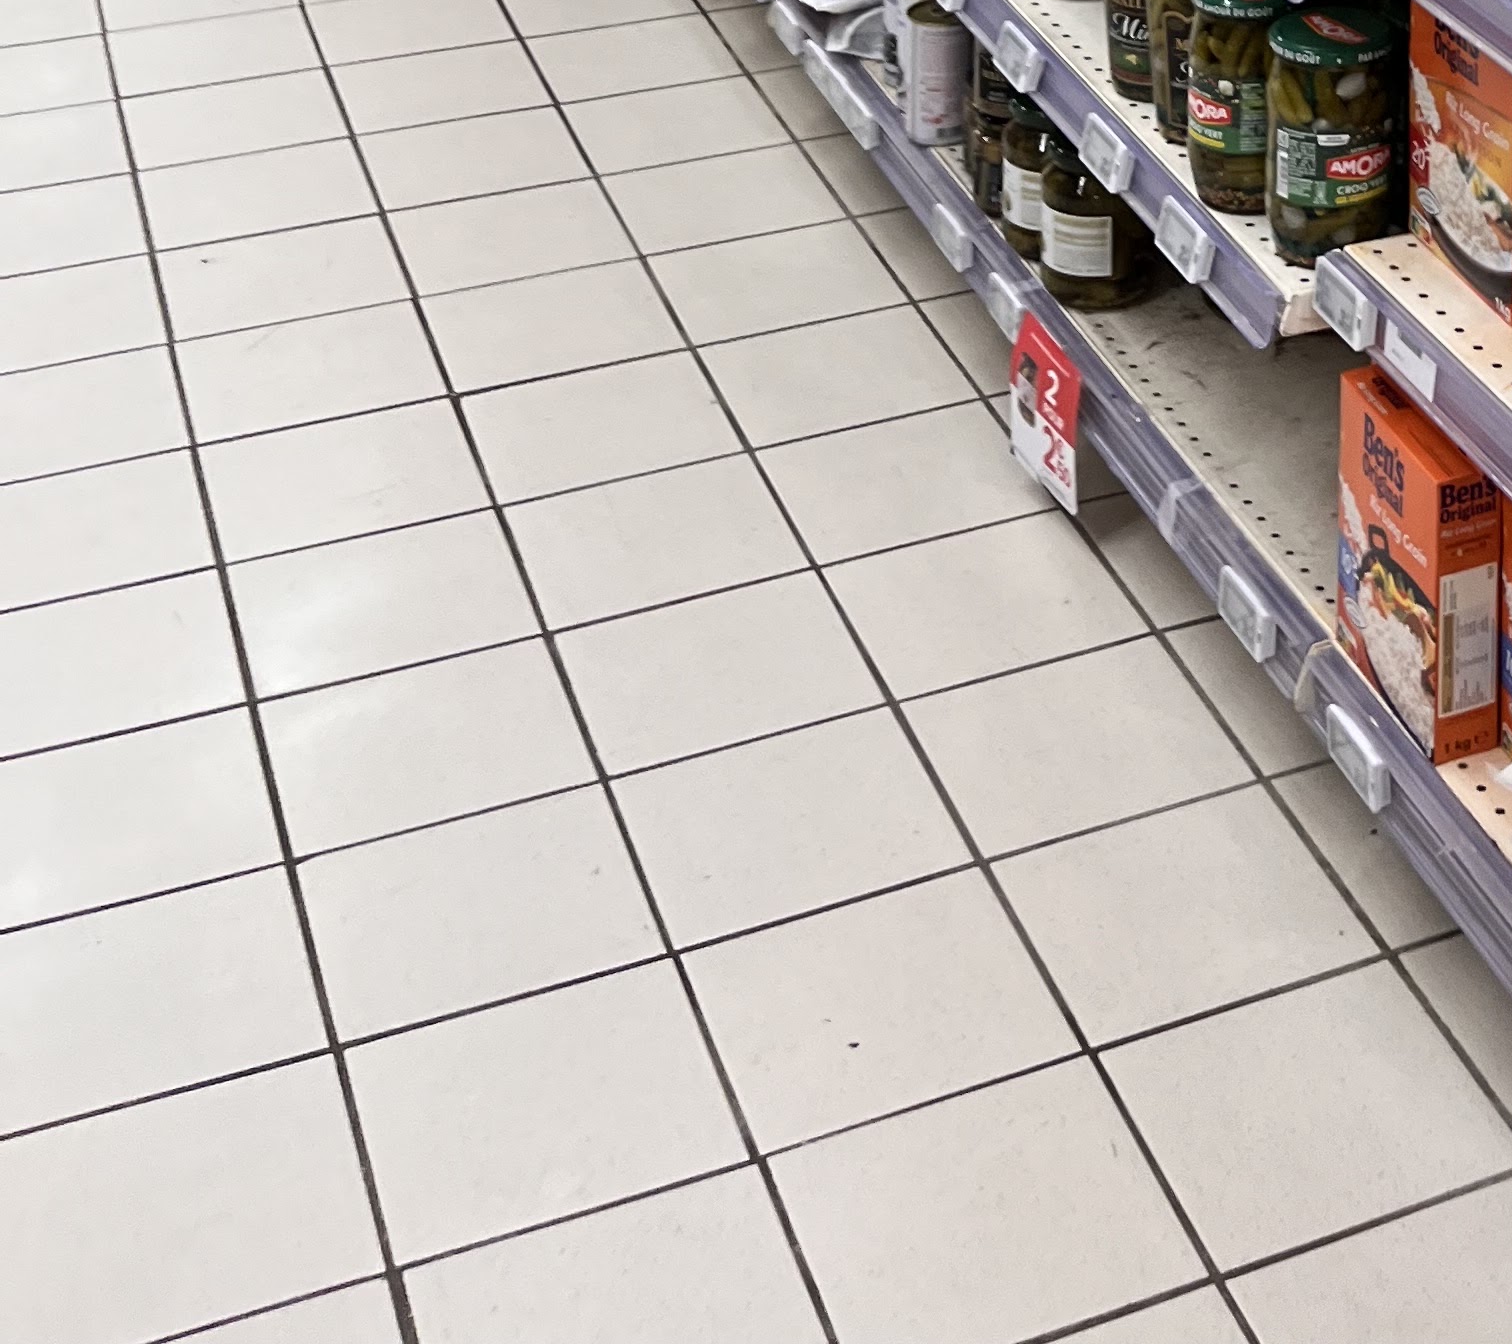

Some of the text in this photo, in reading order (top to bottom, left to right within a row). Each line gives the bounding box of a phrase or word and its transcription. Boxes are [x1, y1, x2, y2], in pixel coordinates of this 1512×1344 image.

[1045, 369, 1059, 406] 2
[1363, 452, 1403, 518] Original
[1364, 413, 1405, 491] Ben's
